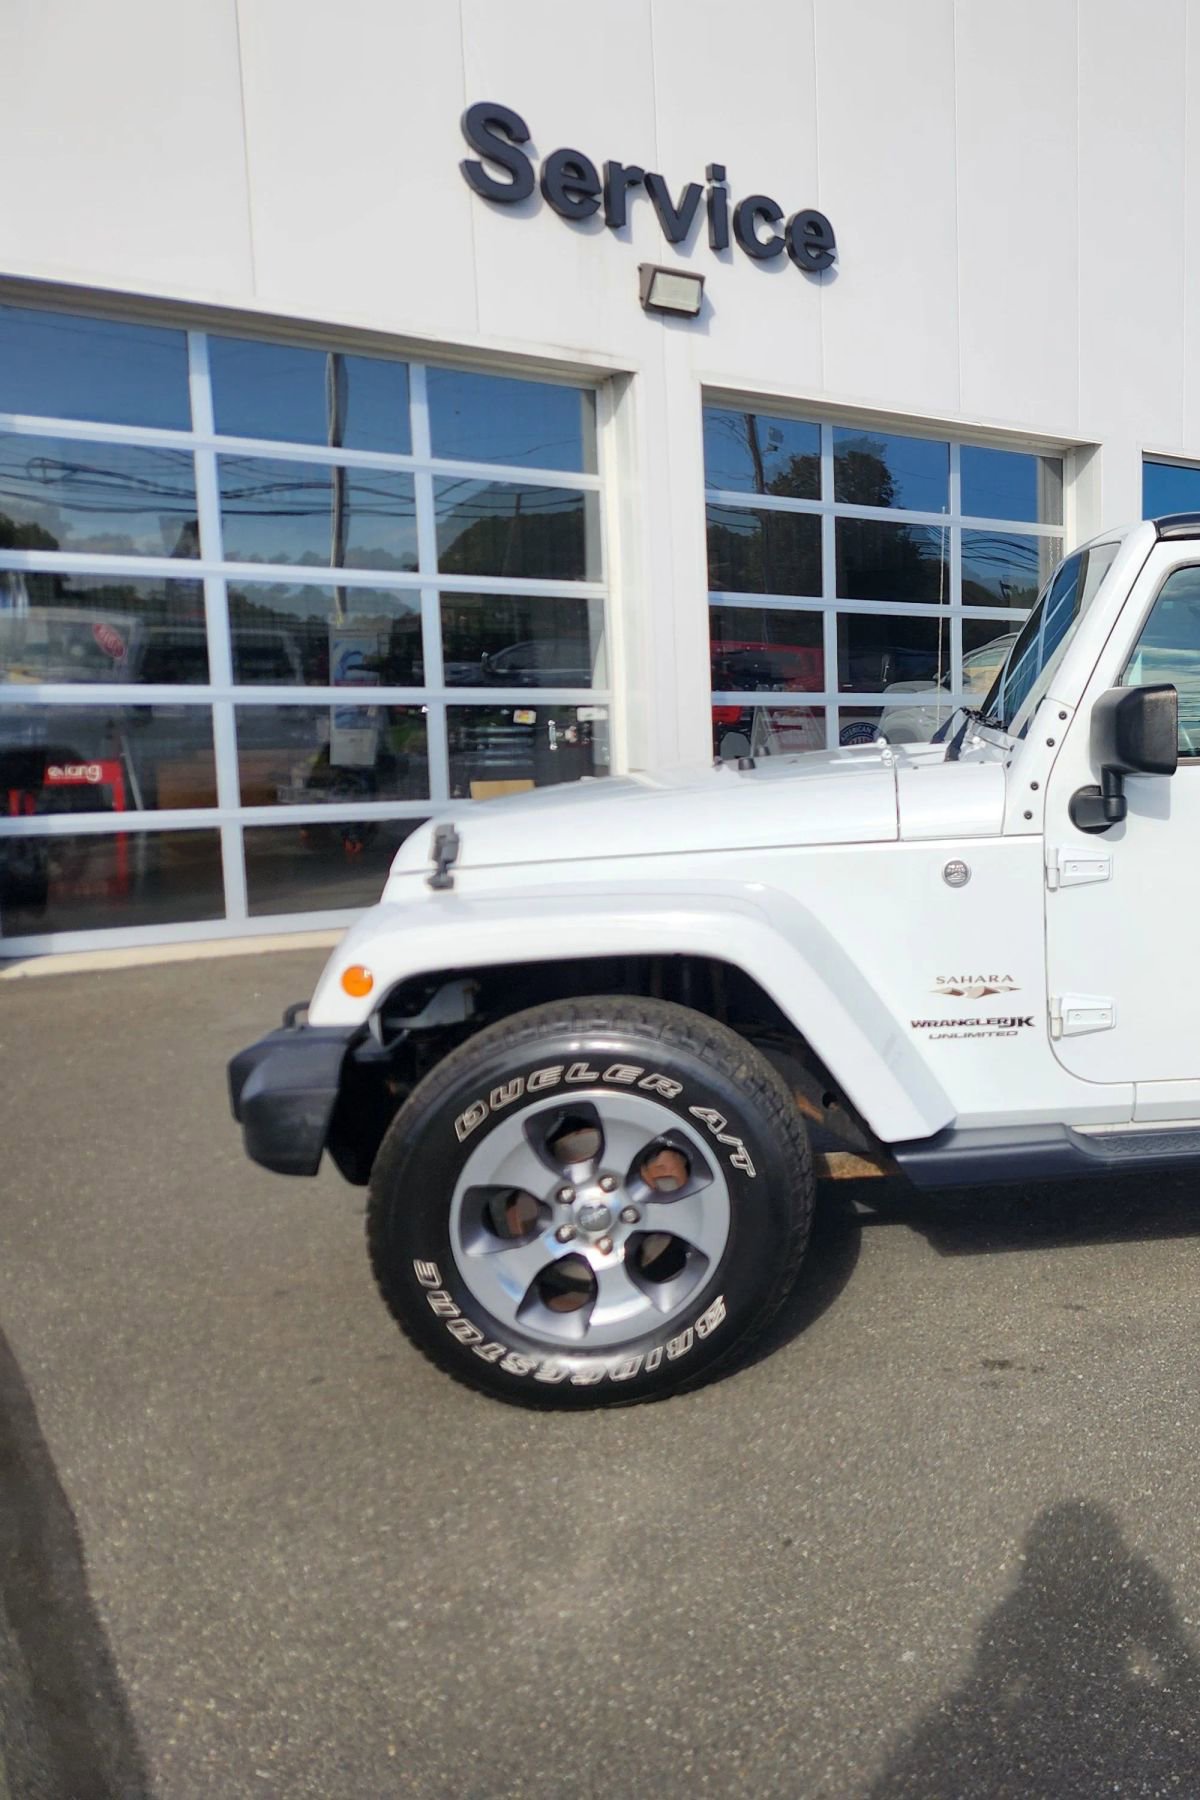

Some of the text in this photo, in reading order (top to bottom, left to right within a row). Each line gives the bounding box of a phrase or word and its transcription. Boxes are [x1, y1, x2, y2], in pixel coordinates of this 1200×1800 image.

[459, 101, 836, 272] Service
[935, 974, 1014, 985] SAHARA
[911, 1017, 1008, 1028] WRANGLER
[928, 1030, 1019, 1040] UNLIMITED
[454, 1062, 757, 1178] DUELER A/T
[413, 1259, 727, 1386] BRIDGESTONE
